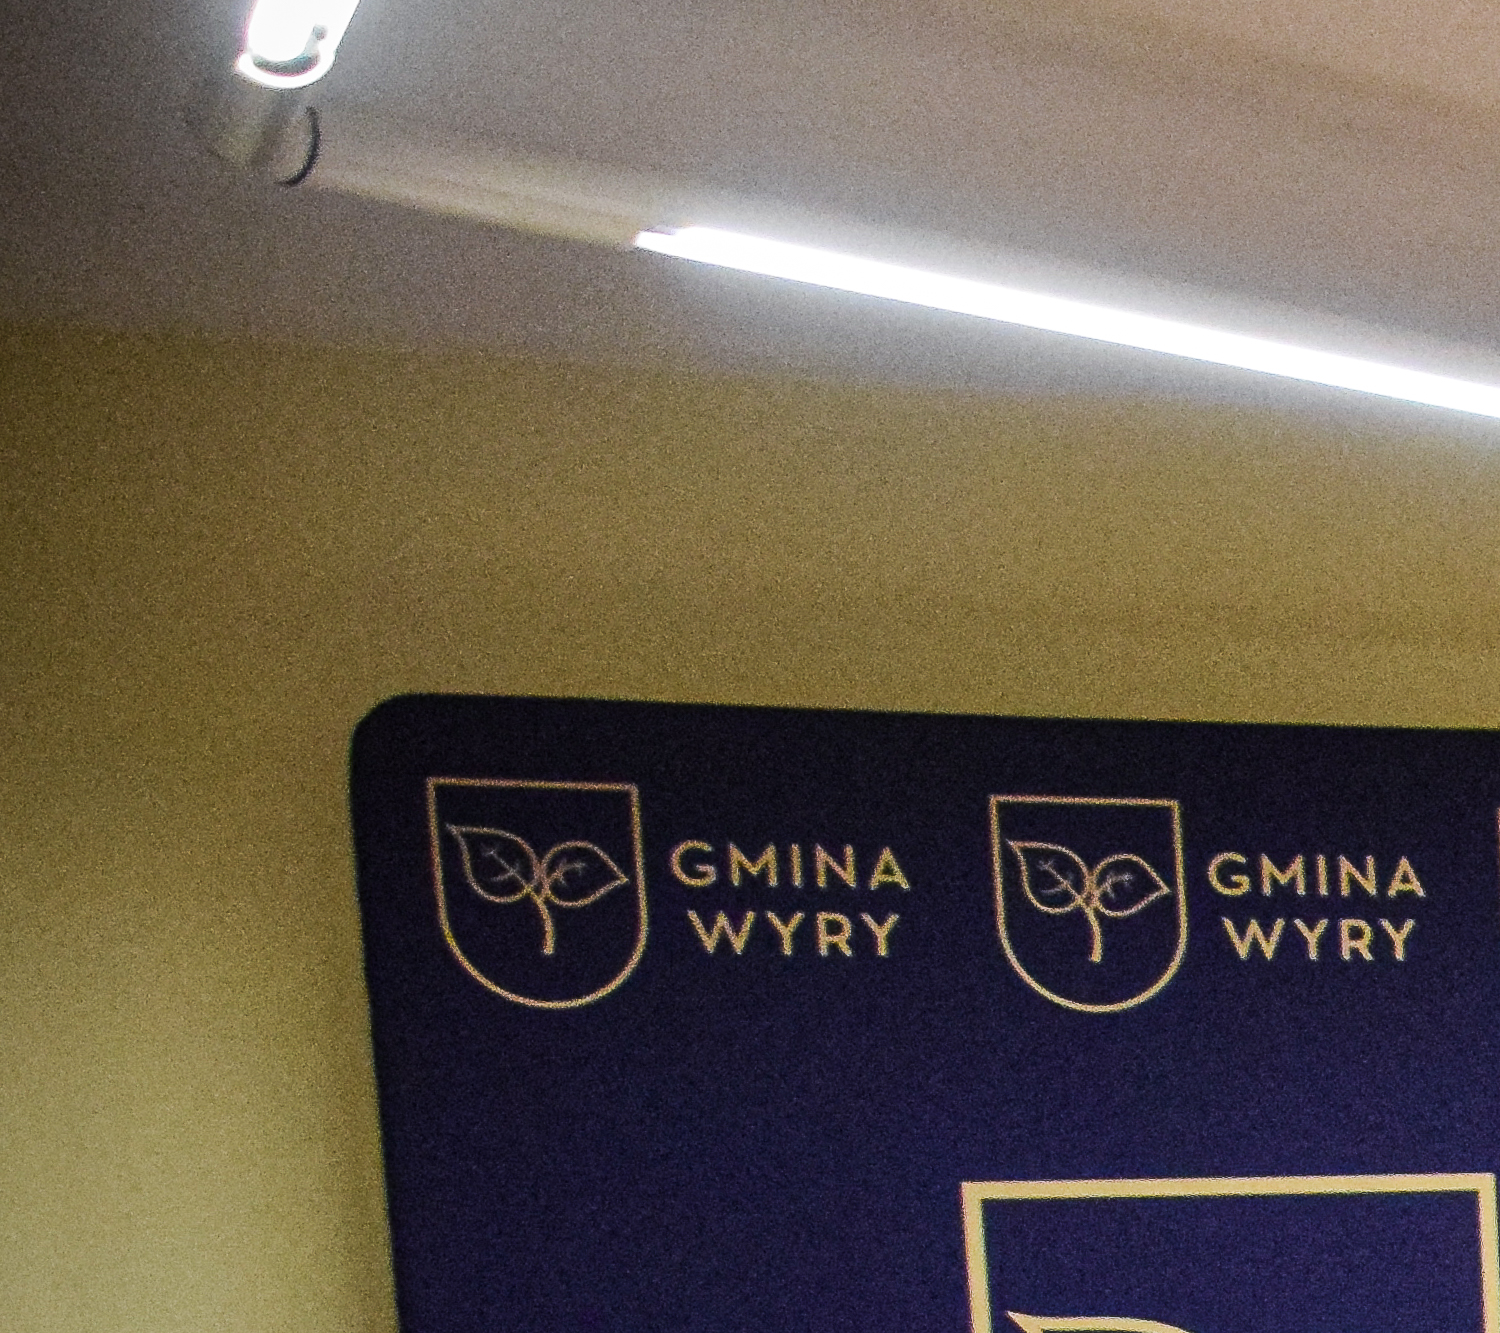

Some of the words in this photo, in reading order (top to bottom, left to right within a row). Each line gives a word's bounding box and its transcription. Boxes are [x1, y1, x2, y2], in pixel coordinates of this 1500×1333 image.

[670, 840, 910, 890] GMINA
[1207, 851, 1425, 897] GMINA
[687, 910, 900, 957] WYRY
[1222, 917, 1416, 961] WYRY
